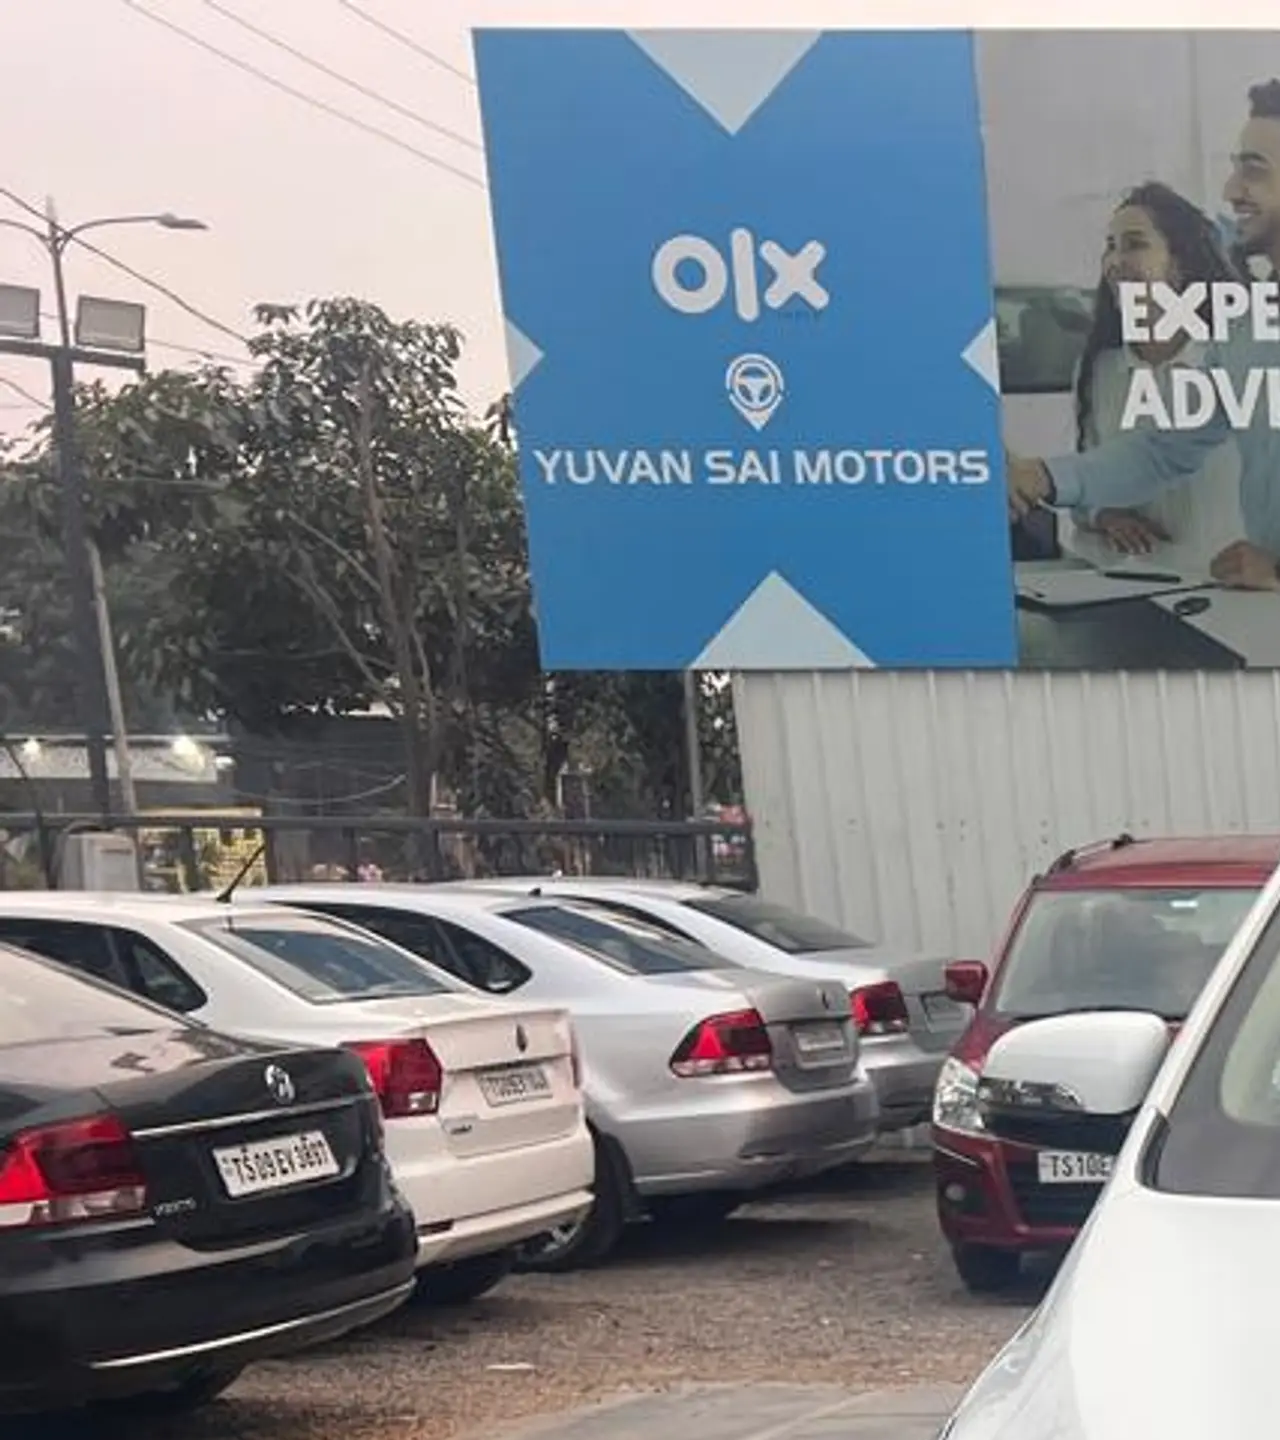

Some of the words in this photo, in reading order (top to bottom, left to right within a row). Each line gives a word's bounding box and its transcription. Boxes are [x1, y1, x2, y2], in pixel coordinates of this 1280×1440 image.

[532, 449, 693, 485] YUVAN
[704, 450, 782, 485] SAI
[793, 449, 990, 484] MOTORS
